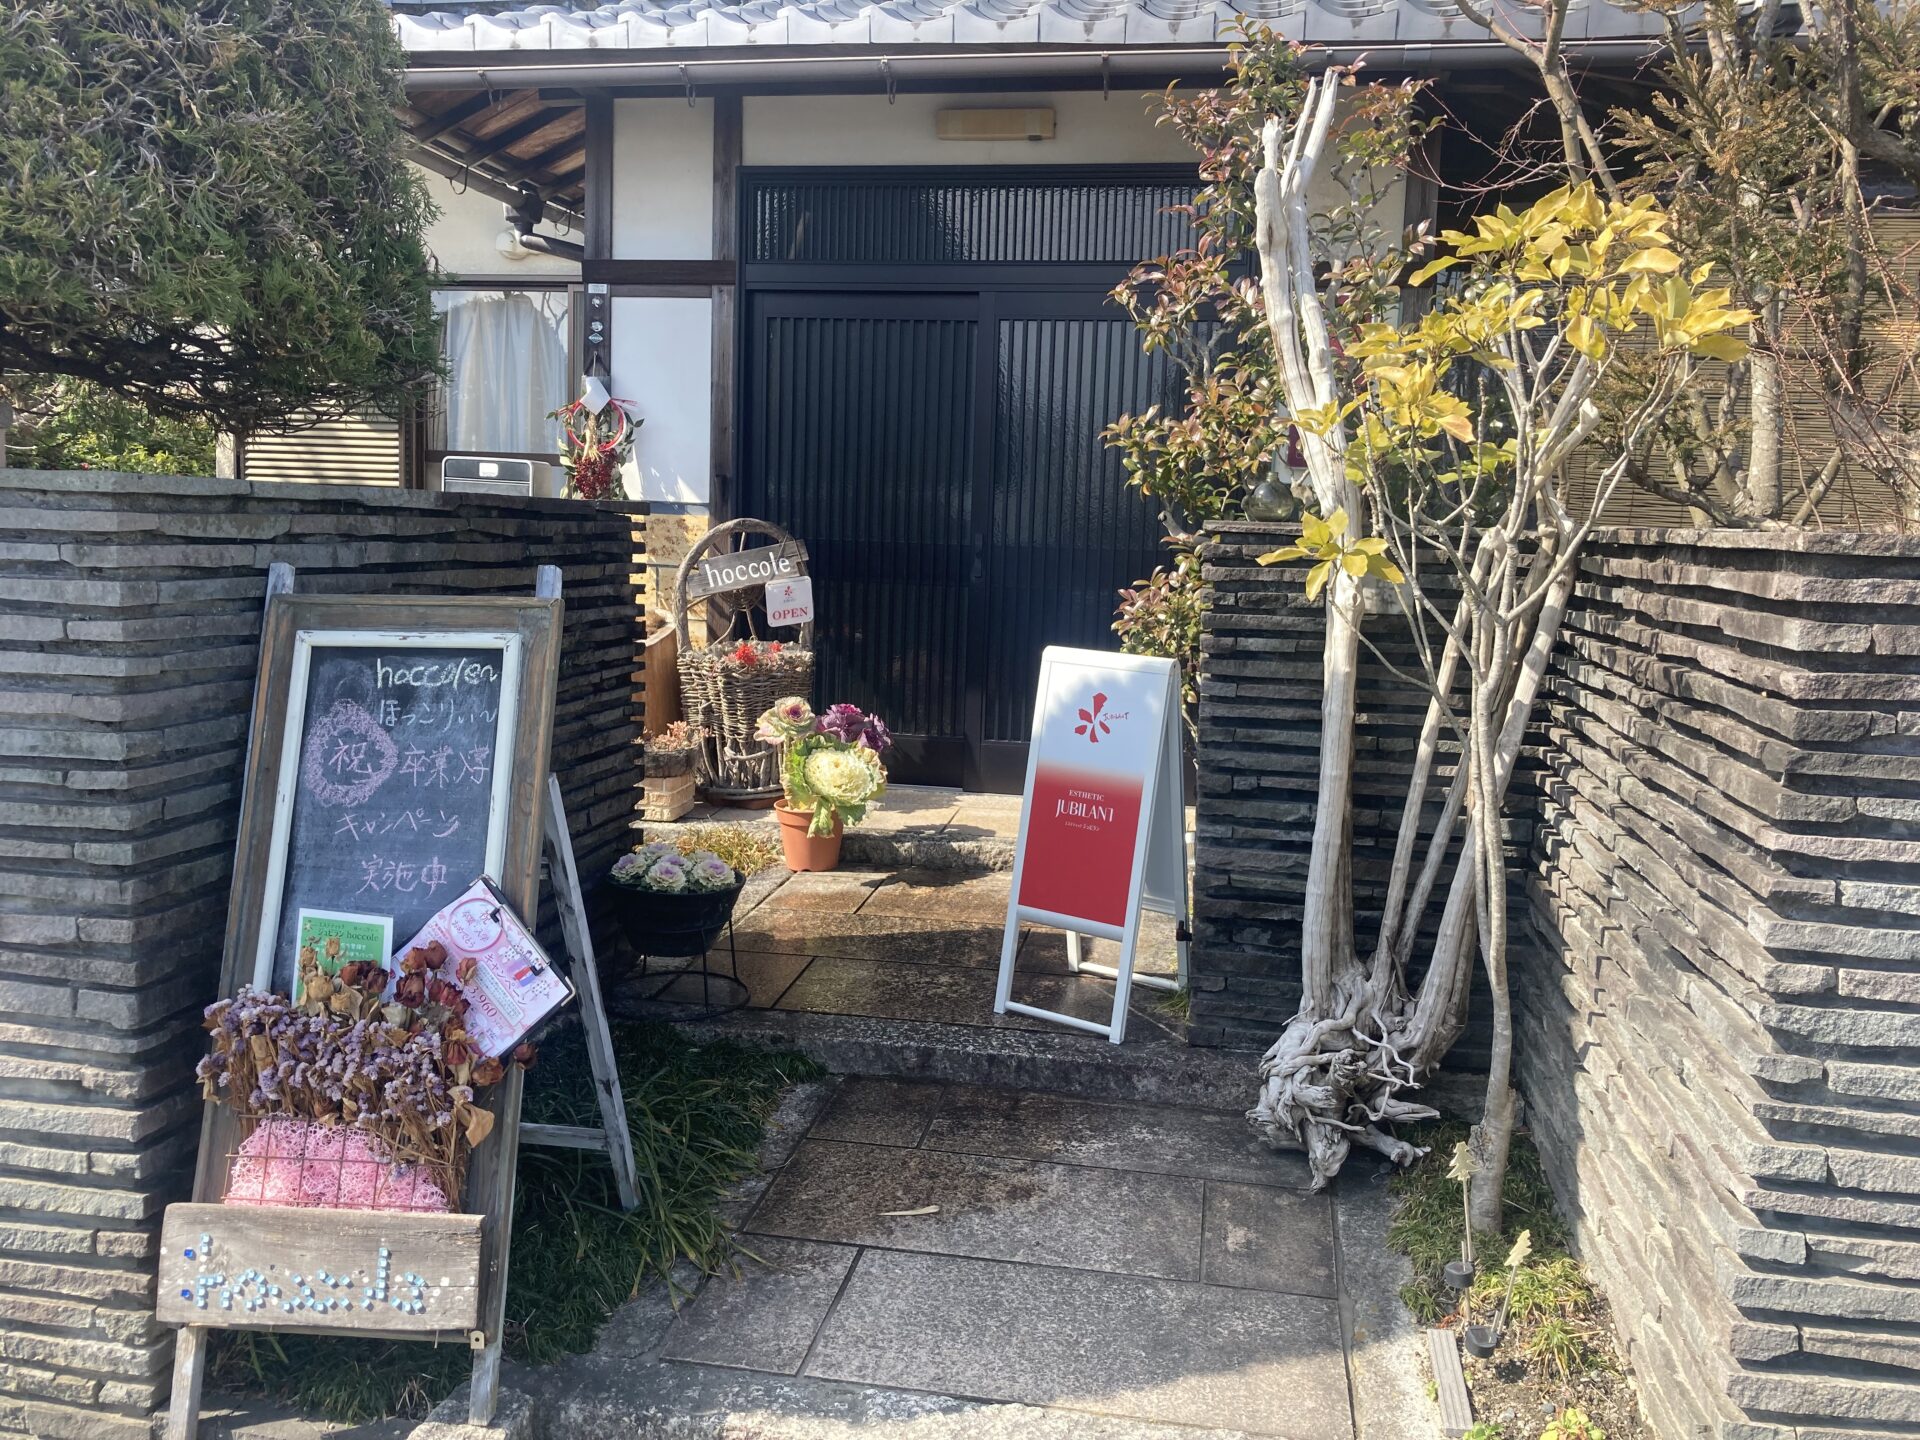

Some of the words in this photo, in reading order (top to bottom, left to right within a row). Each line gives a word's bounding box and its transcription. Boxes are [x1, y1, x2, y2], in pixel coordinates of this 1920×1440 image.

[705, 551, 791, 588] hoccole
[772, 607, 808, 621] OPEN
[1055, 798, 1114, 823] JUBILANT
[1069, 789, 1105, 802] ESTHETIC
[335, 808, 460, 841] キャンペーン
[356, 854, 447, 900] 実施中
[346, 931, 380, 942] hoccole
[484, 954, 527, 1005] キャンペーン
[468, 986, 498, 1018] 3,960
